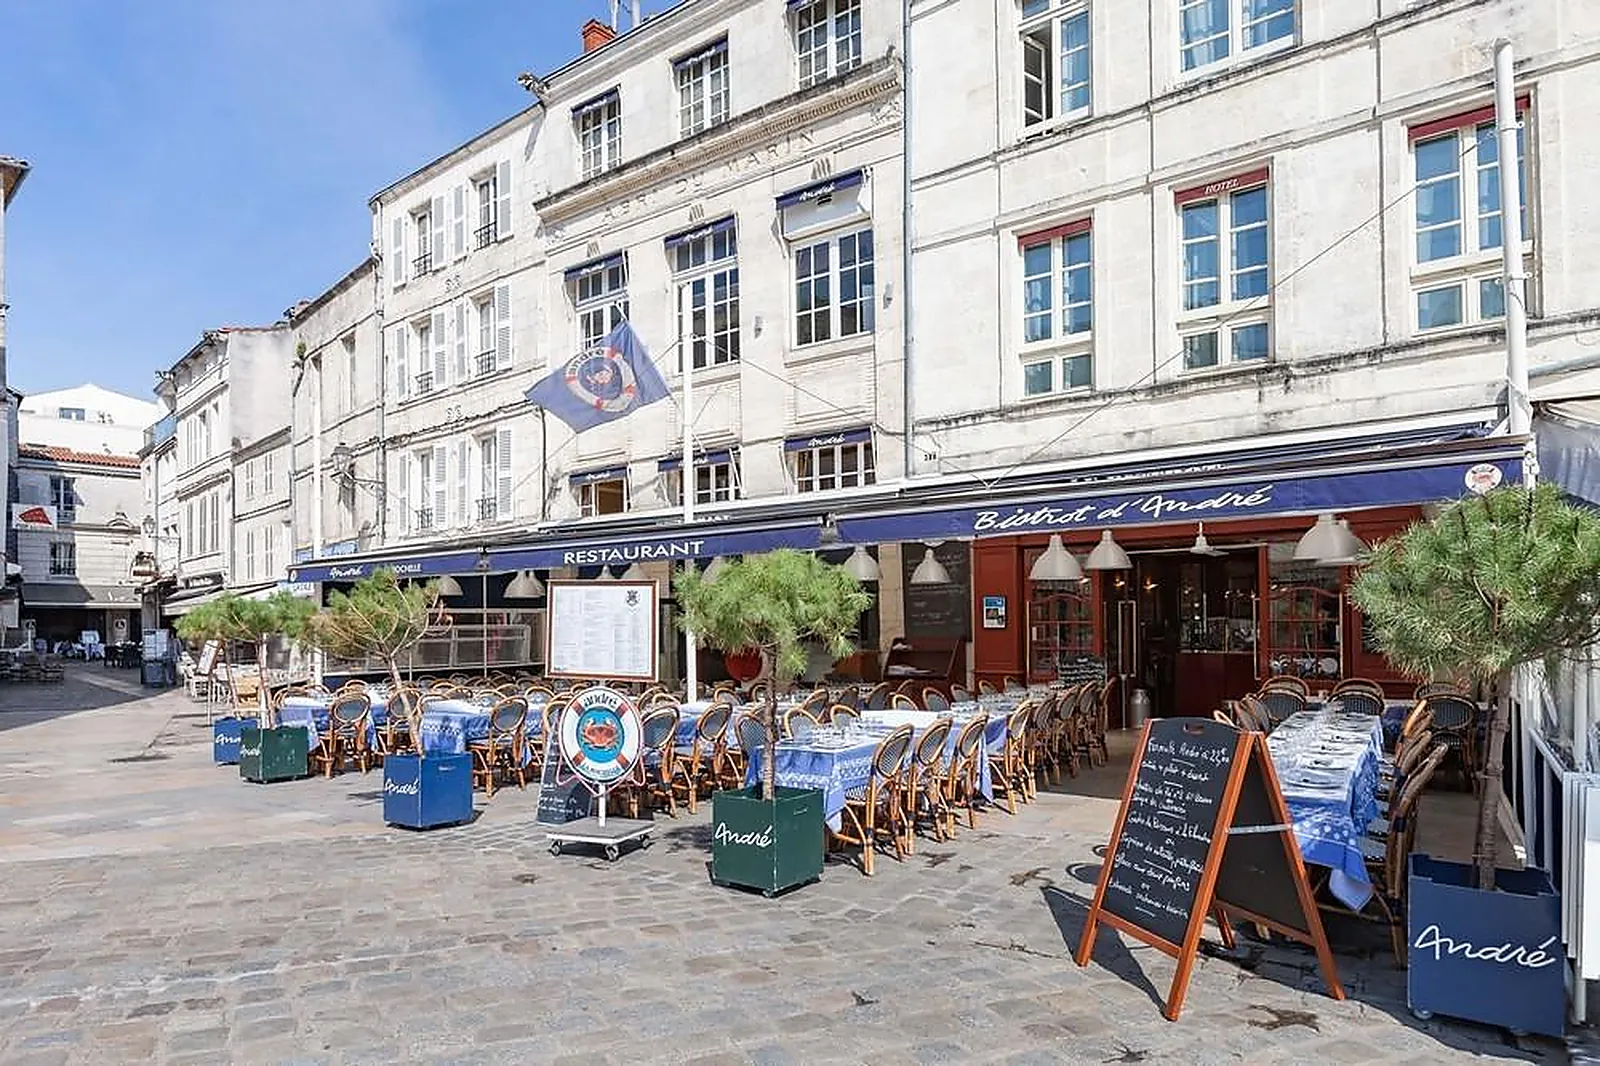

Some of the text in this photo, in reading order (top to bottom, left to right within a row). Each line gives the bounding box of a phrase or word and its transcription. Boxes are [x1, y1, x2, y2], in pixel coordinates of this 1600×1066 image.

[723, 129, 816, 178] MARIN
[1203, 178, 1240, 195] HOTEL
[973, 484, 1274, 532] Bistrot d'André
[563, 540, 705, 565] RESTAURANT
[384, 777, 420, 795] André
[714, 821, 774, 848] André
[1413, 924, 1558, 969] André
